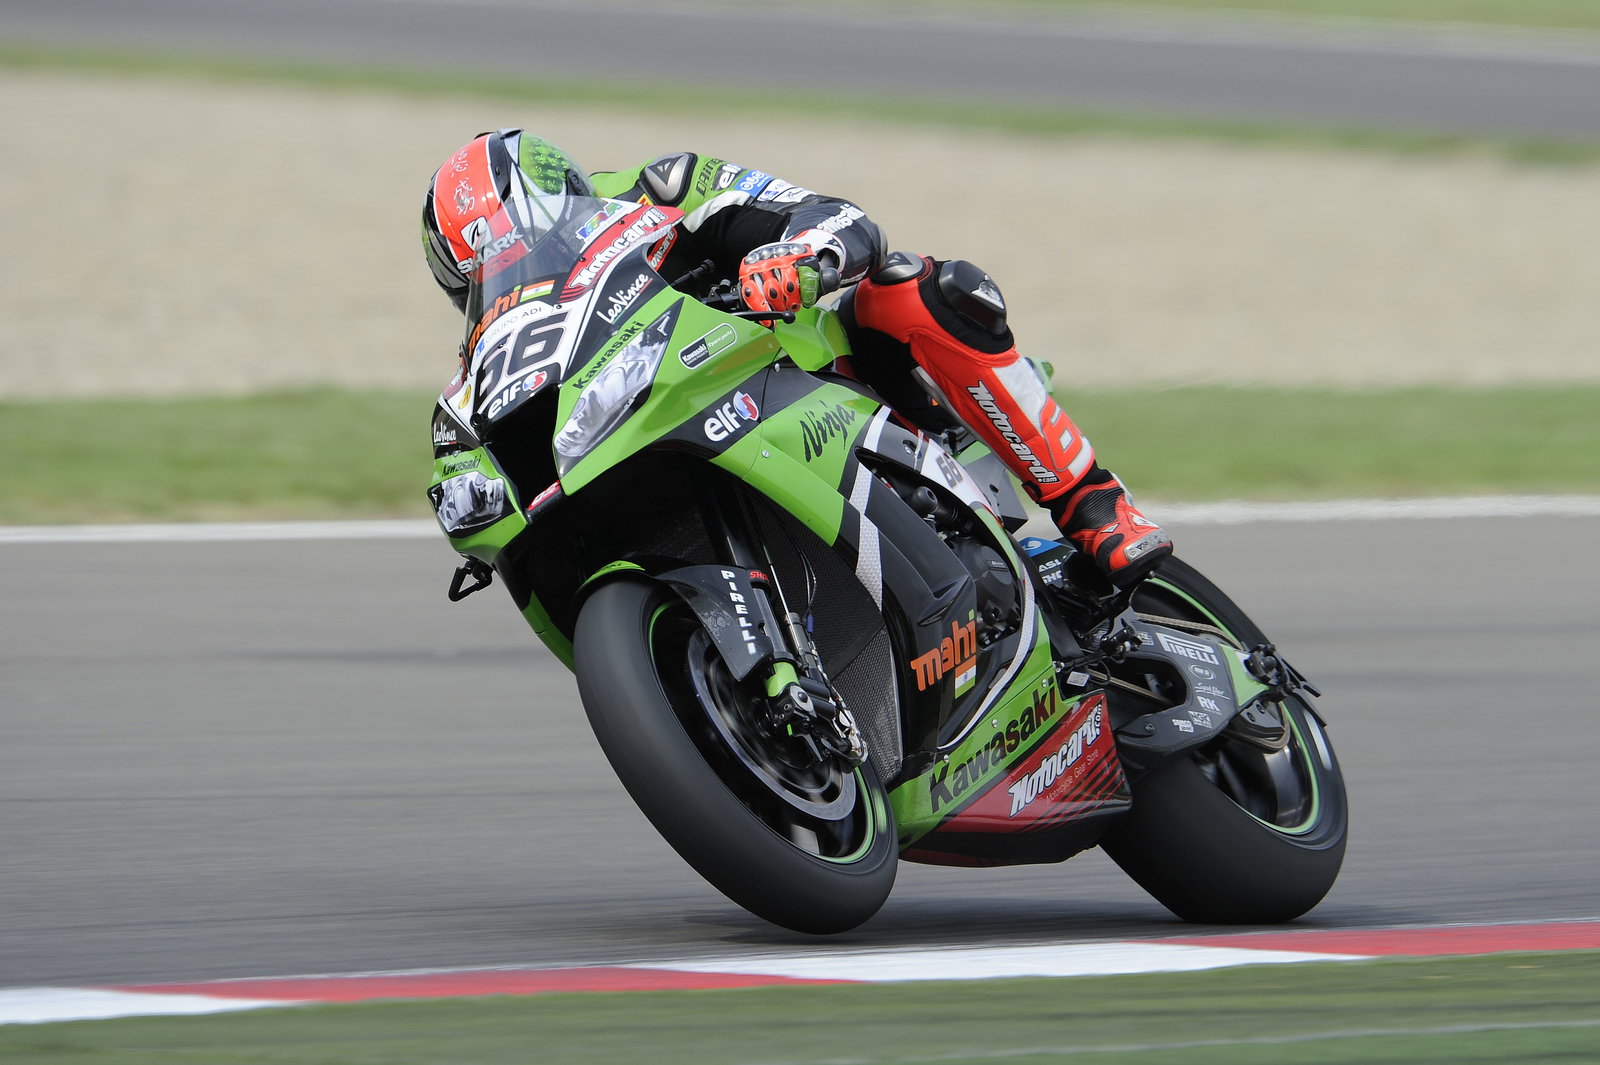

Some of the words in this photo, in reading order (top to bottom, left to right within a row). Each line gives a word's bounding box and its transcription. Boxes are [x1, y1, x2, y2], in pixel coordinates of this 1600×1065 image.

[457, 225, 524, 274] SHARK
[521, 307, 542, 318] ADI
[572, 320, 645, 390] Kawasaki
[487, 381, 523, 419] elf
[704, 401, 743, 442] elf
[800, 400, 856, 463] Ninja
[442, 455, 481, 478] Kawasaki
[720, 569, 757, 656] PIRELLI
[910, 608, 977, 692] mahi
[1156, 632, 1220, 666] PIRELLI
[1197, 695, 1221, 711] RK
[929, 675, 1056, 814] Kawasaki
